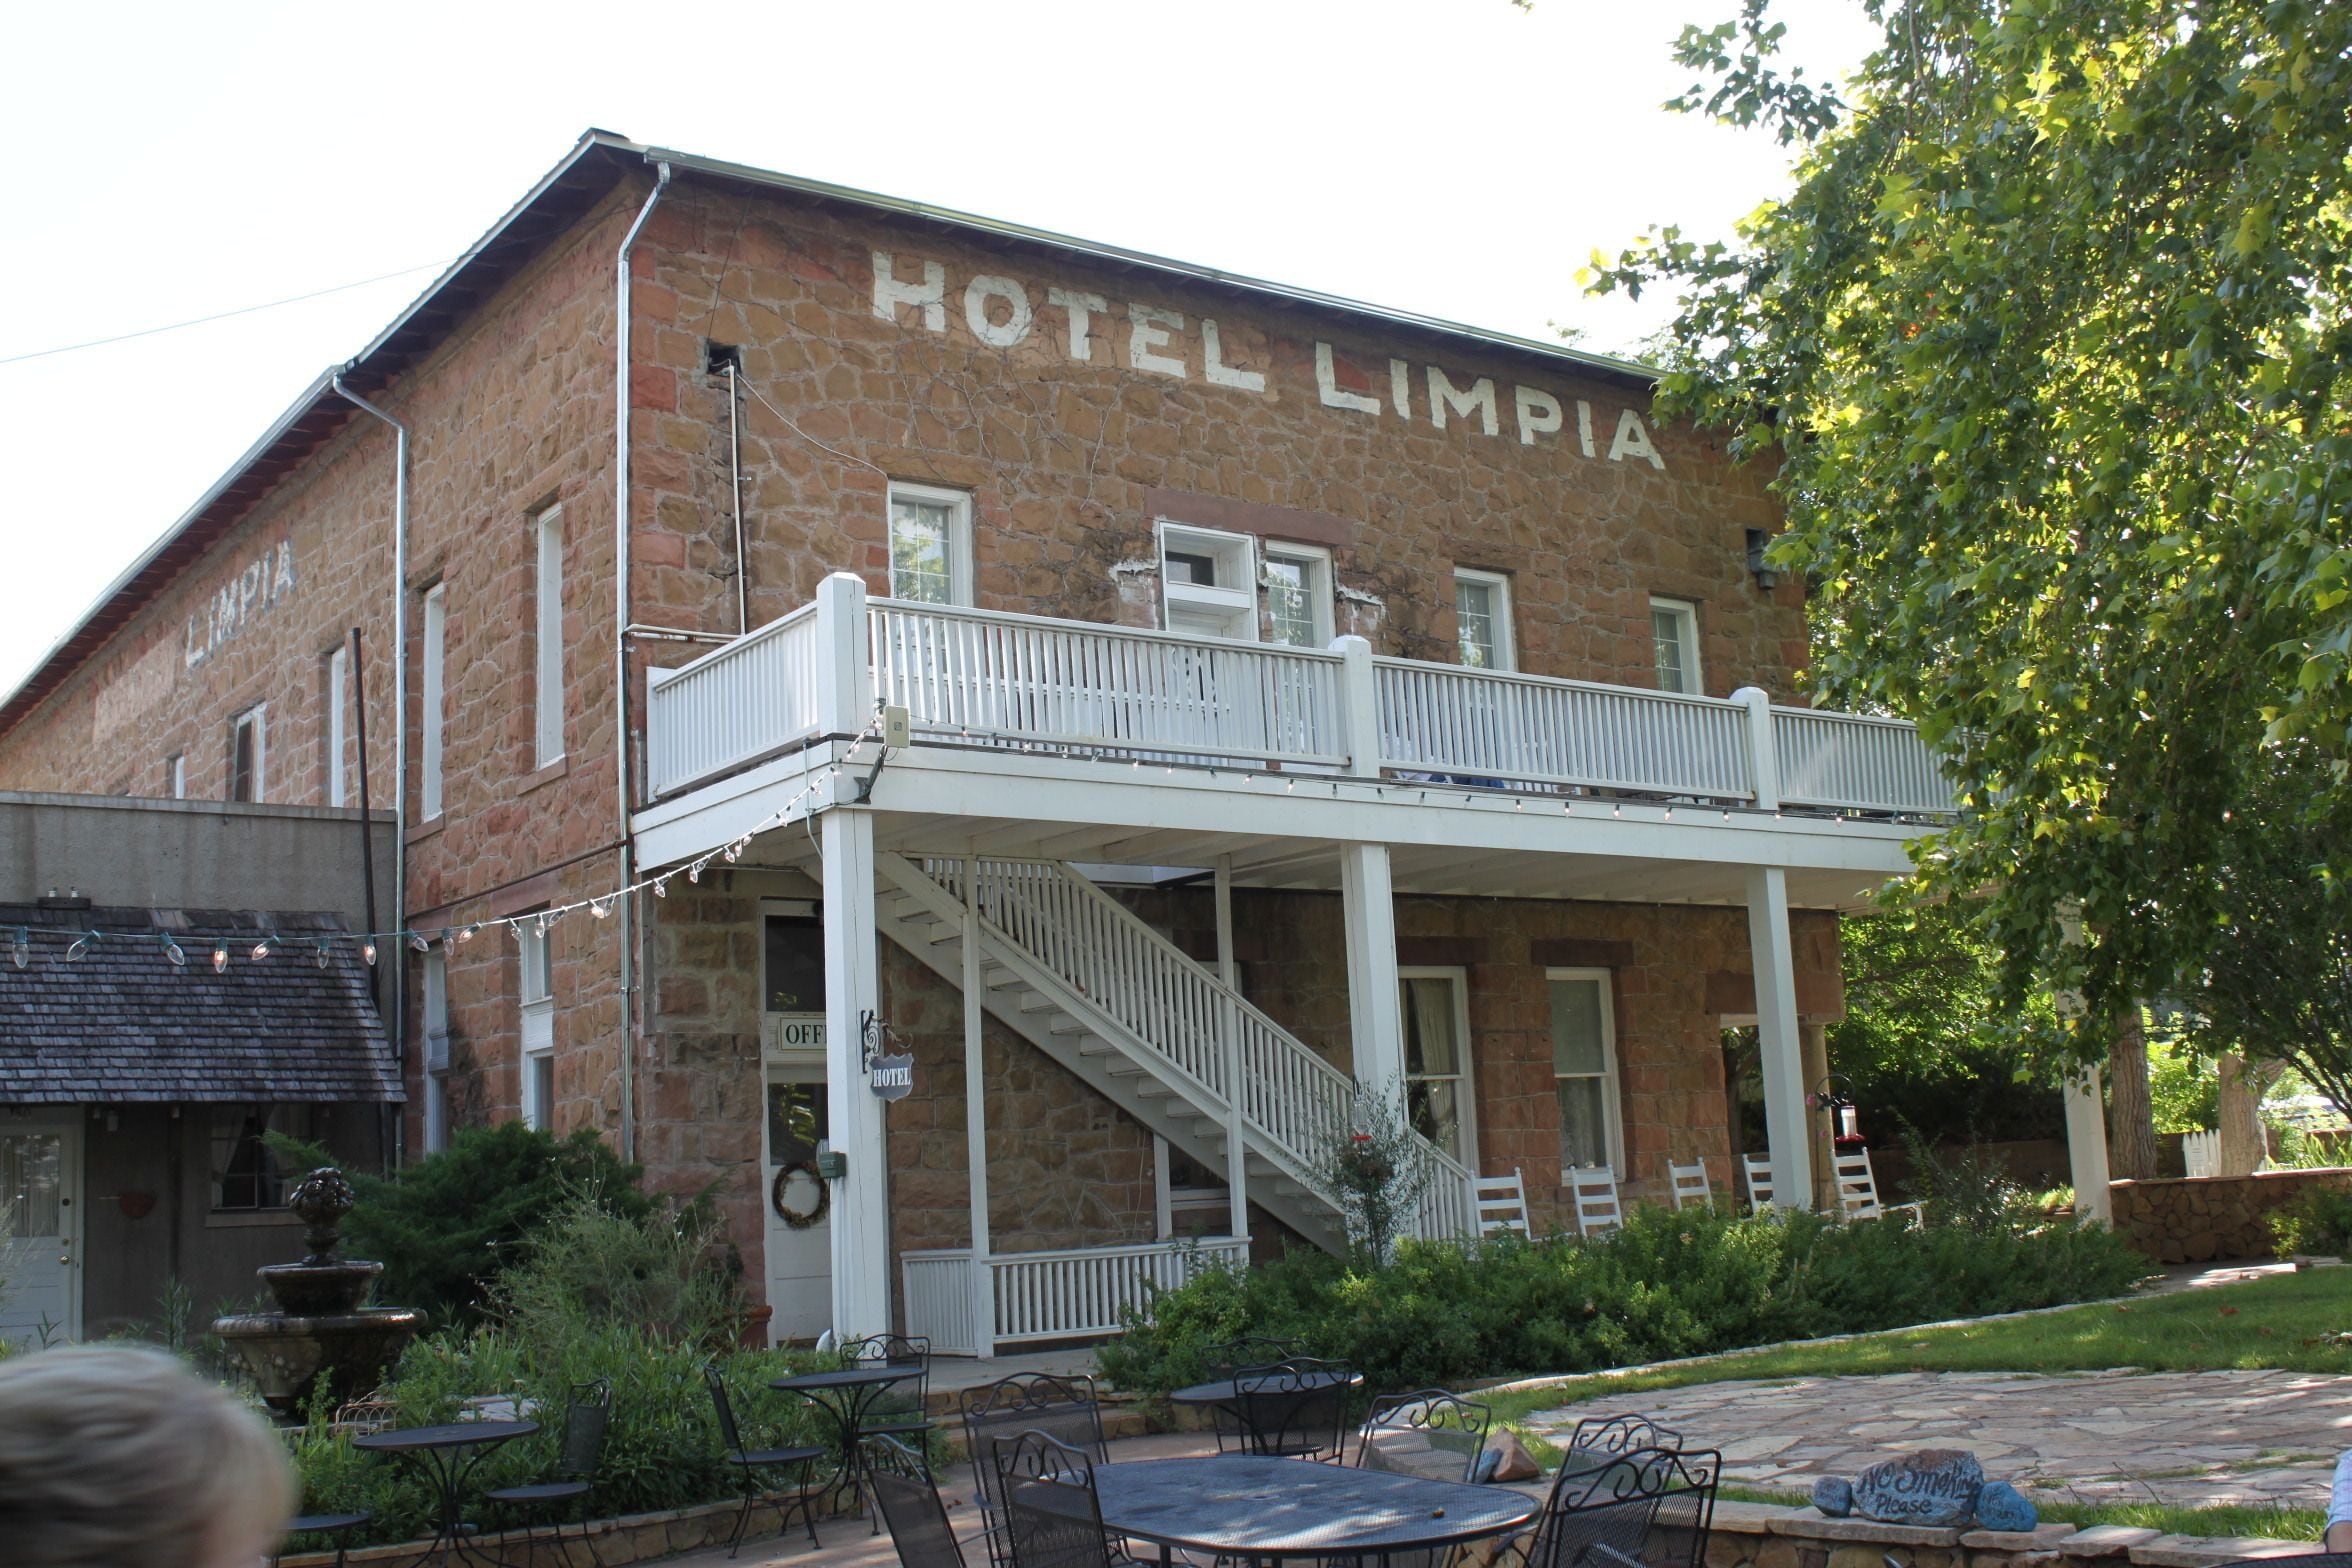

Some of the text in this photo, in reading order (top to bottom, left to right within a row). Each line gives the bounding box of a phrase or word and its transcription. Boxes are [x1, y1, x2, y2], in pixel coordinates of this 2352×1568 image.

[872, 250, 1666, 470] HOTEL LIMPIA
[186, 540, 297, 670] LIMPIA
[872, 1067, 911, 1087] HOTEL
[1874, 1493, 1932, 1514] Please
